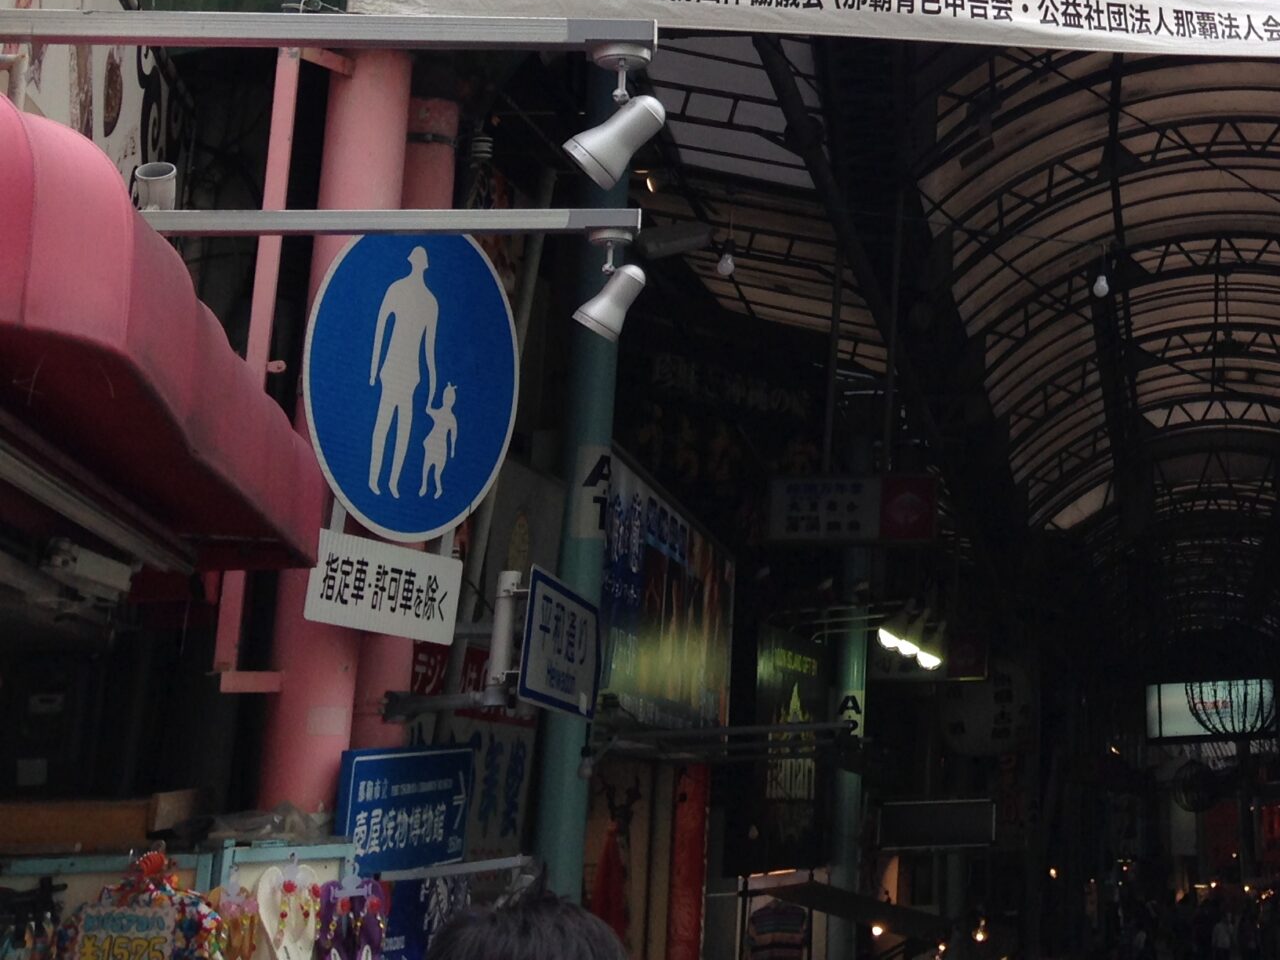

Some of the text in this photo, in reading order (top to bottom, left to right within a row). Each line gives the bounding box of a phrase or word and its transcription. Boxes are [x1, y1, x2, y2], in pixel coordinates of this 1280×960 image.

[320, 551, 449, 622] 指定車・許可車を除く
